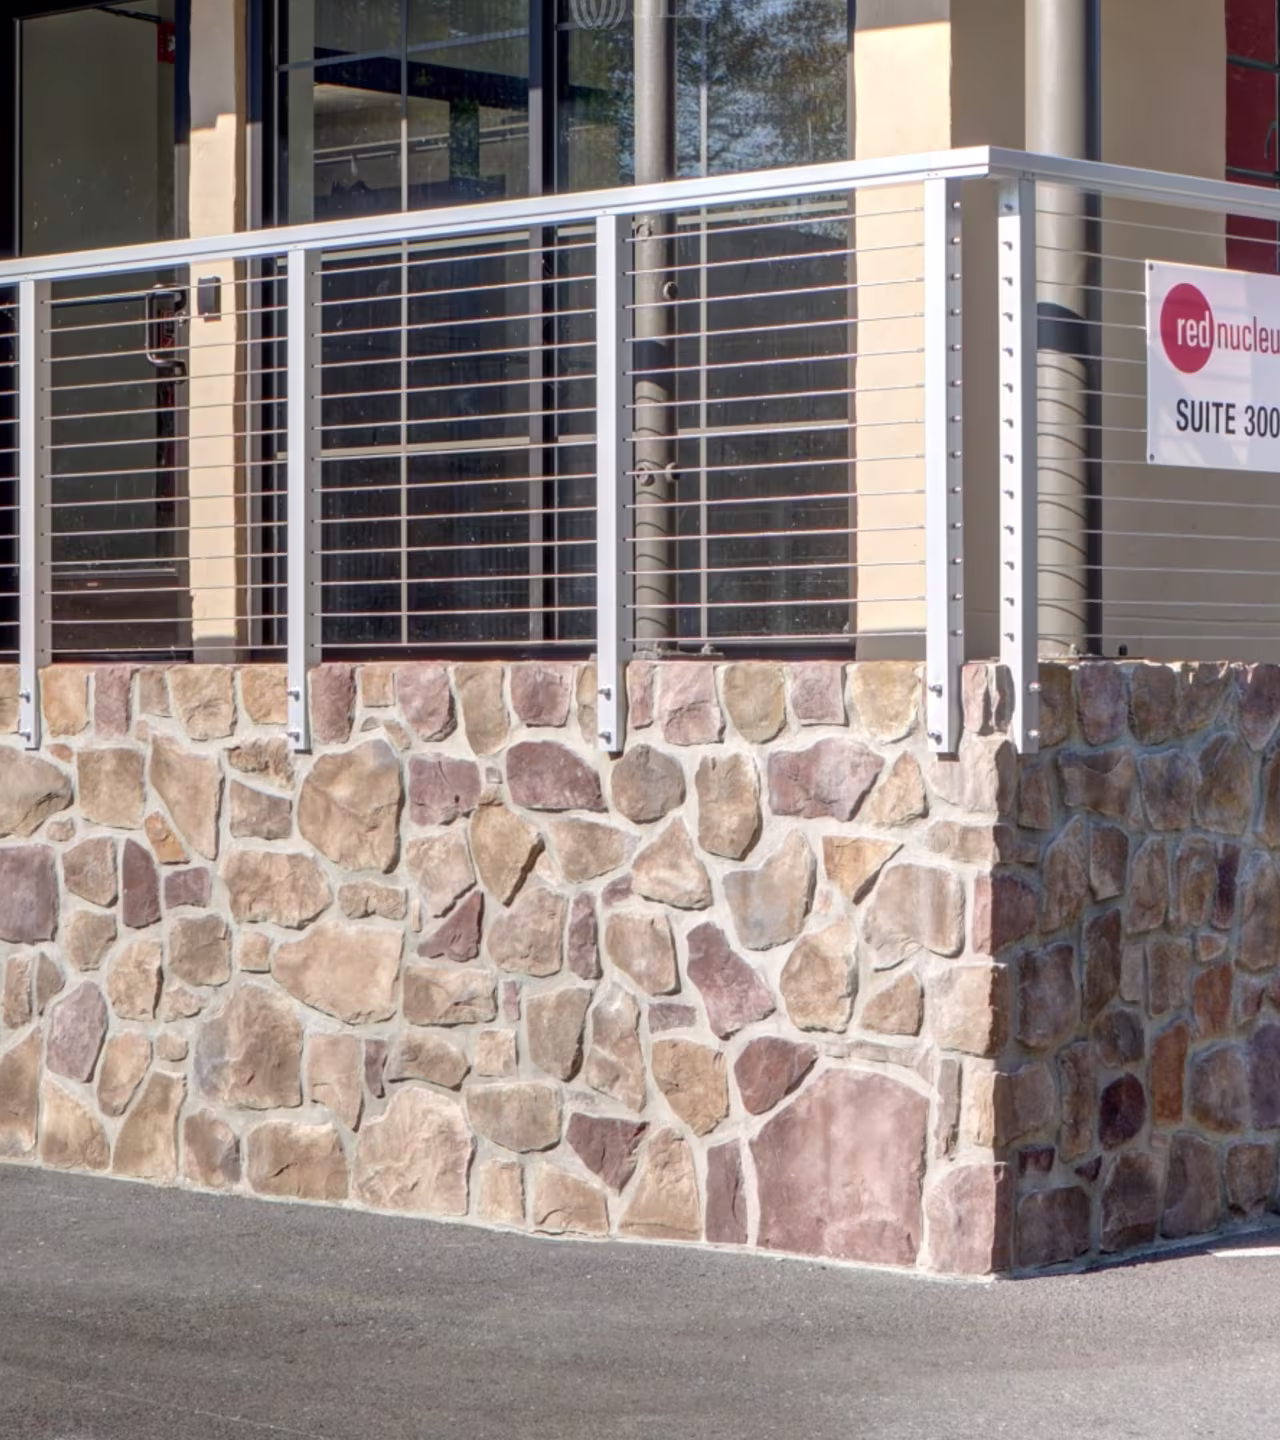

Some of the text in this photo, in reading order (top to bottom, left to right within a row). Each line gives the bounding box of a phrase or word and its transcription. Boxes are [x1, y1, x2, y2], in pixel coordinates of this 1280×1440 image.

[1177, 310, 1211, 348] red
[1176, 398, 1280, 439] SUITE 300
